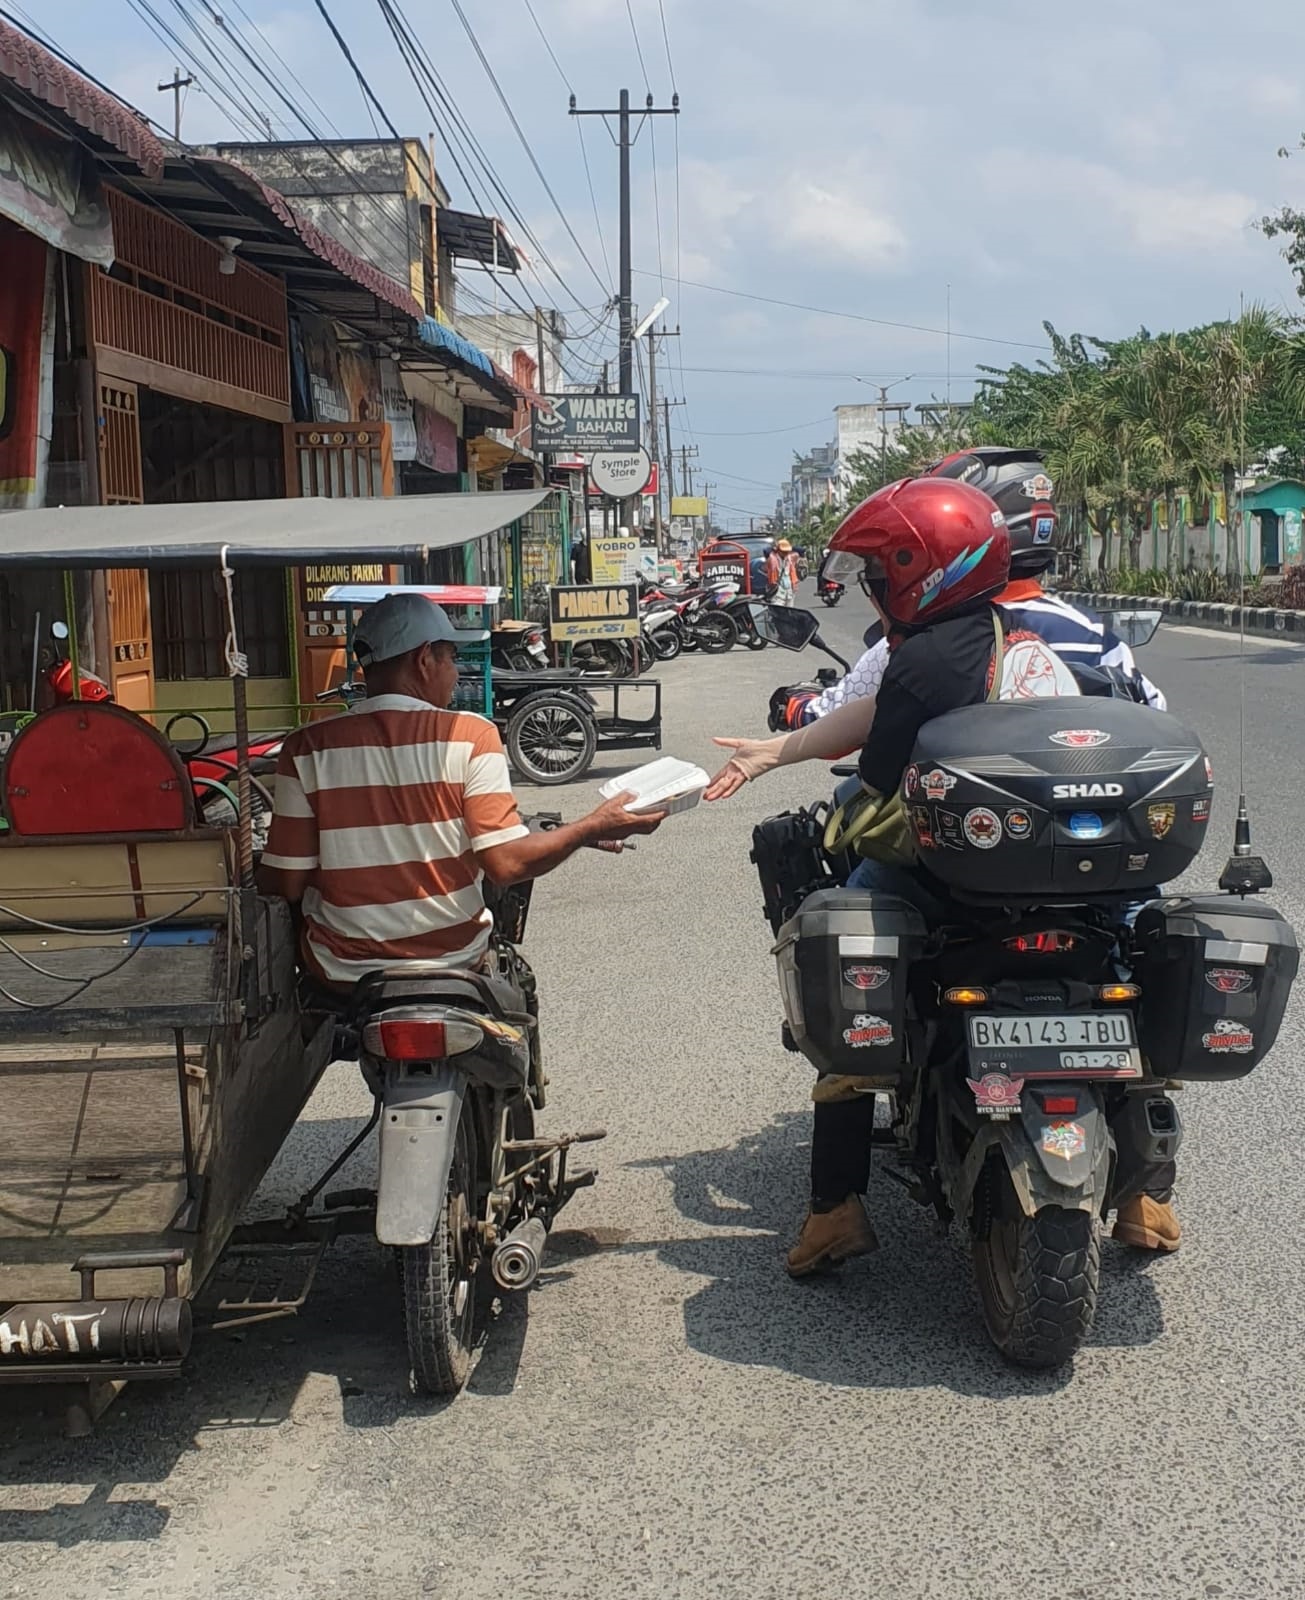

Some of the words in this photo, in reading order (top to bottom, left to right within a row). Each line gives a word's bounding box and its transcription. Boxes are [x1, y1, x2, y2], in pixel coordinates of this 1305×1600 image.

[567, 398, 636, 419] WARTEG
[576, 421, 628, 433] BAHARI
[601, 457, 640, 470] Symple
[610, 468, 637, 478] Store
[595, 542, 636, 551] YOBRO
[305, 565, 350, 583] DILARANG
[352, 564, 384, 582] PARKIR
[558, 589, 630, 618] PANGKAS
[1052, 783, 1124, 799] SHAD
[975, 1021, 1006, 1045] BK
[1009, 1021, 1068, 1045] 4143
[1081, 1019, 1126, 1044] TBU
